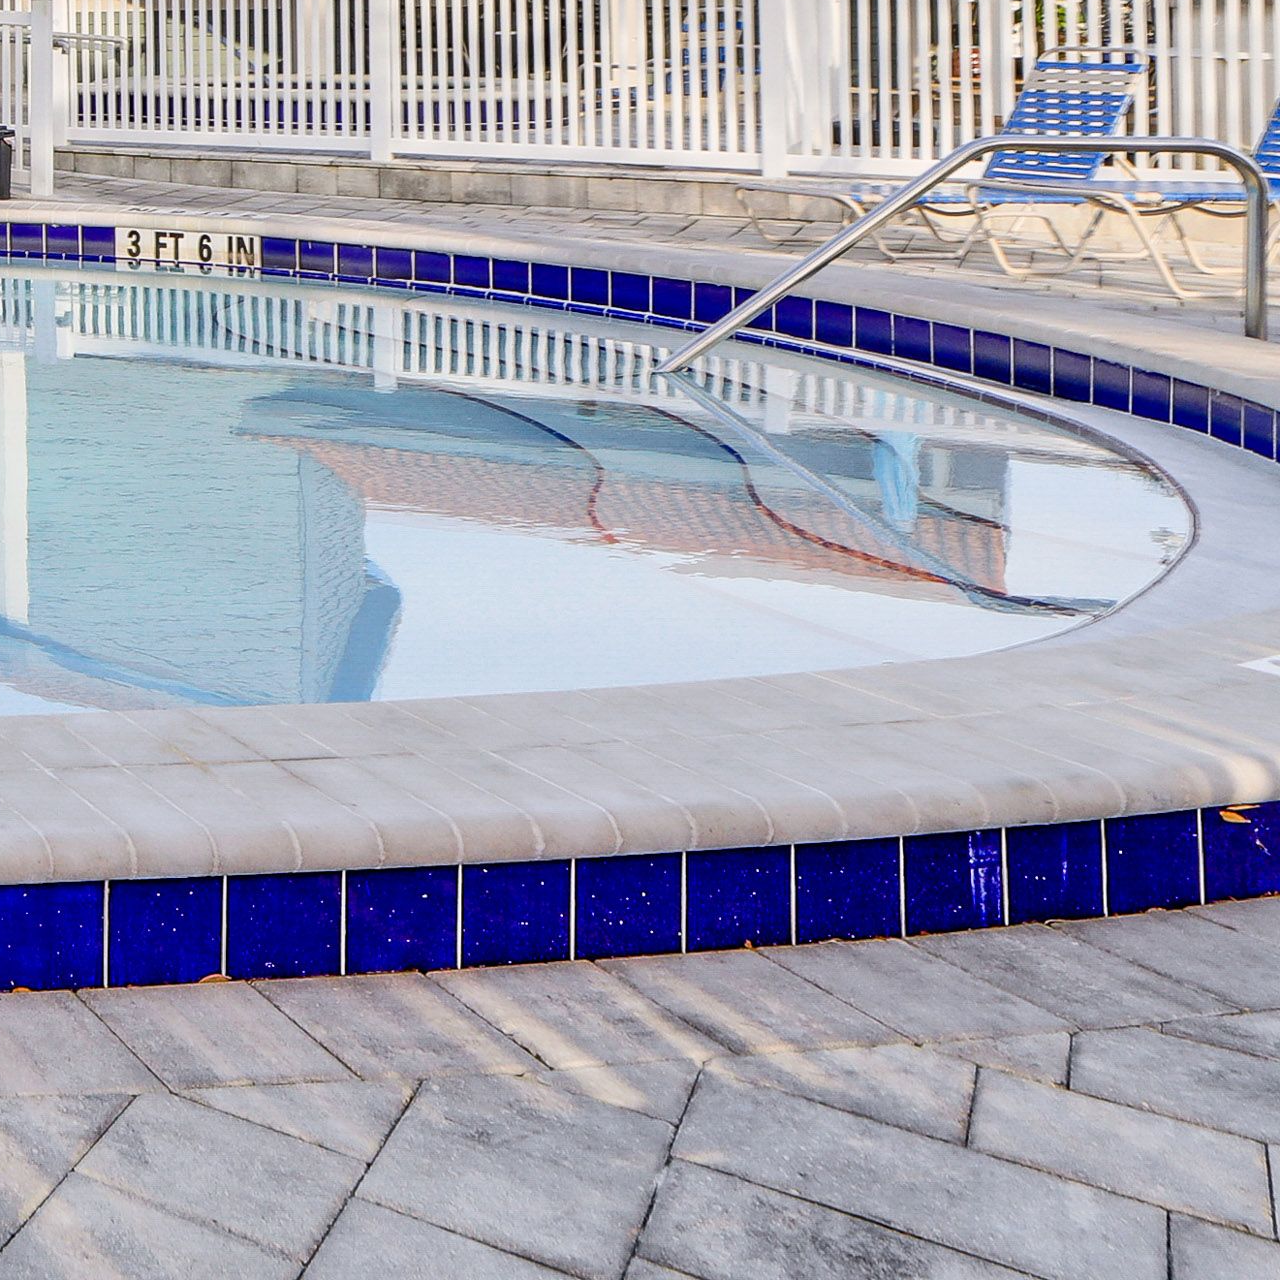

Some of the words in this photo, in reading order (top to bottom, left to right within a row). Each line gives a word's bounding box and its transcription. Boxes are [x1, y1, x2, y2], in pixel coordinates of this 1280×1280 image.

[127, 230, 141, 258] 3
[154, 231, 184, 262] FT
[198, 234, 212, 263] 6
[227, 236, 255, 267] IN
